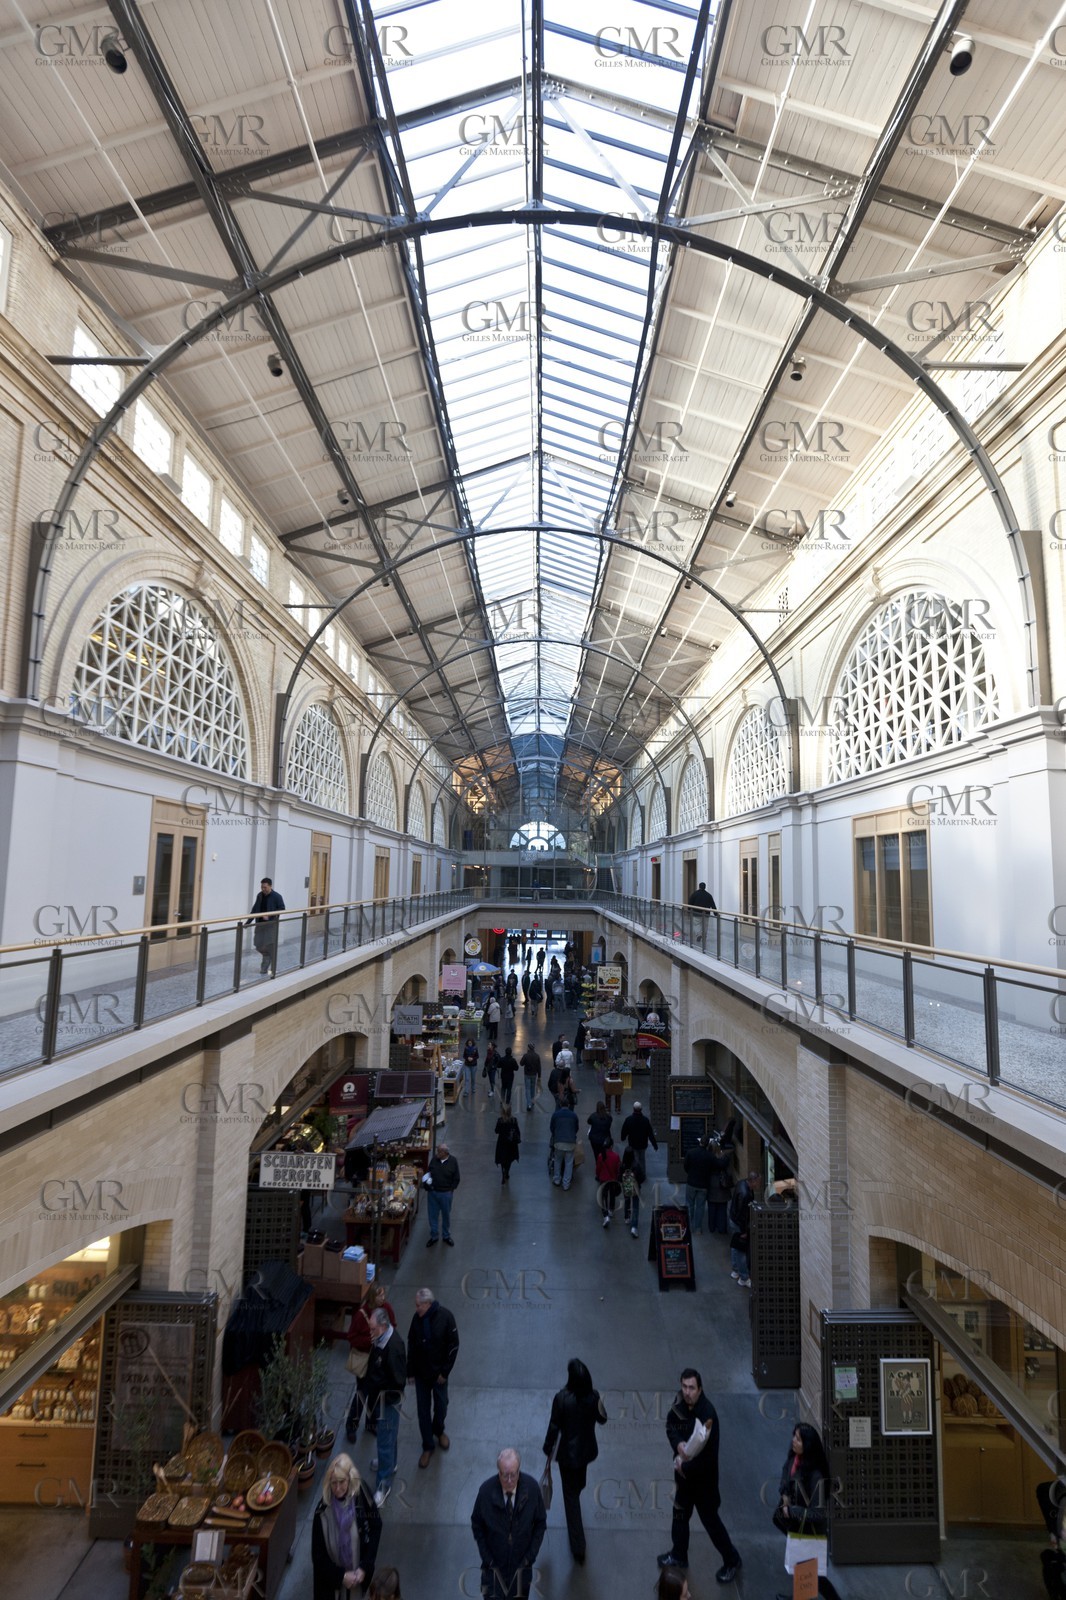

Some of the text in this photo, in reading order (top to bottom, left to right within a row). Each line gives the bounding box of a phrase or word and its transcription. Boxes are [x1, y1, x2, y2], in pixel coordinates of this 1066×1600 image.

[264, 1155, 333, 1170] SCHARFFEN
[273, 1168, 321, 1183] BERGER
[121, 1373, 149, 1384] EXTRA
